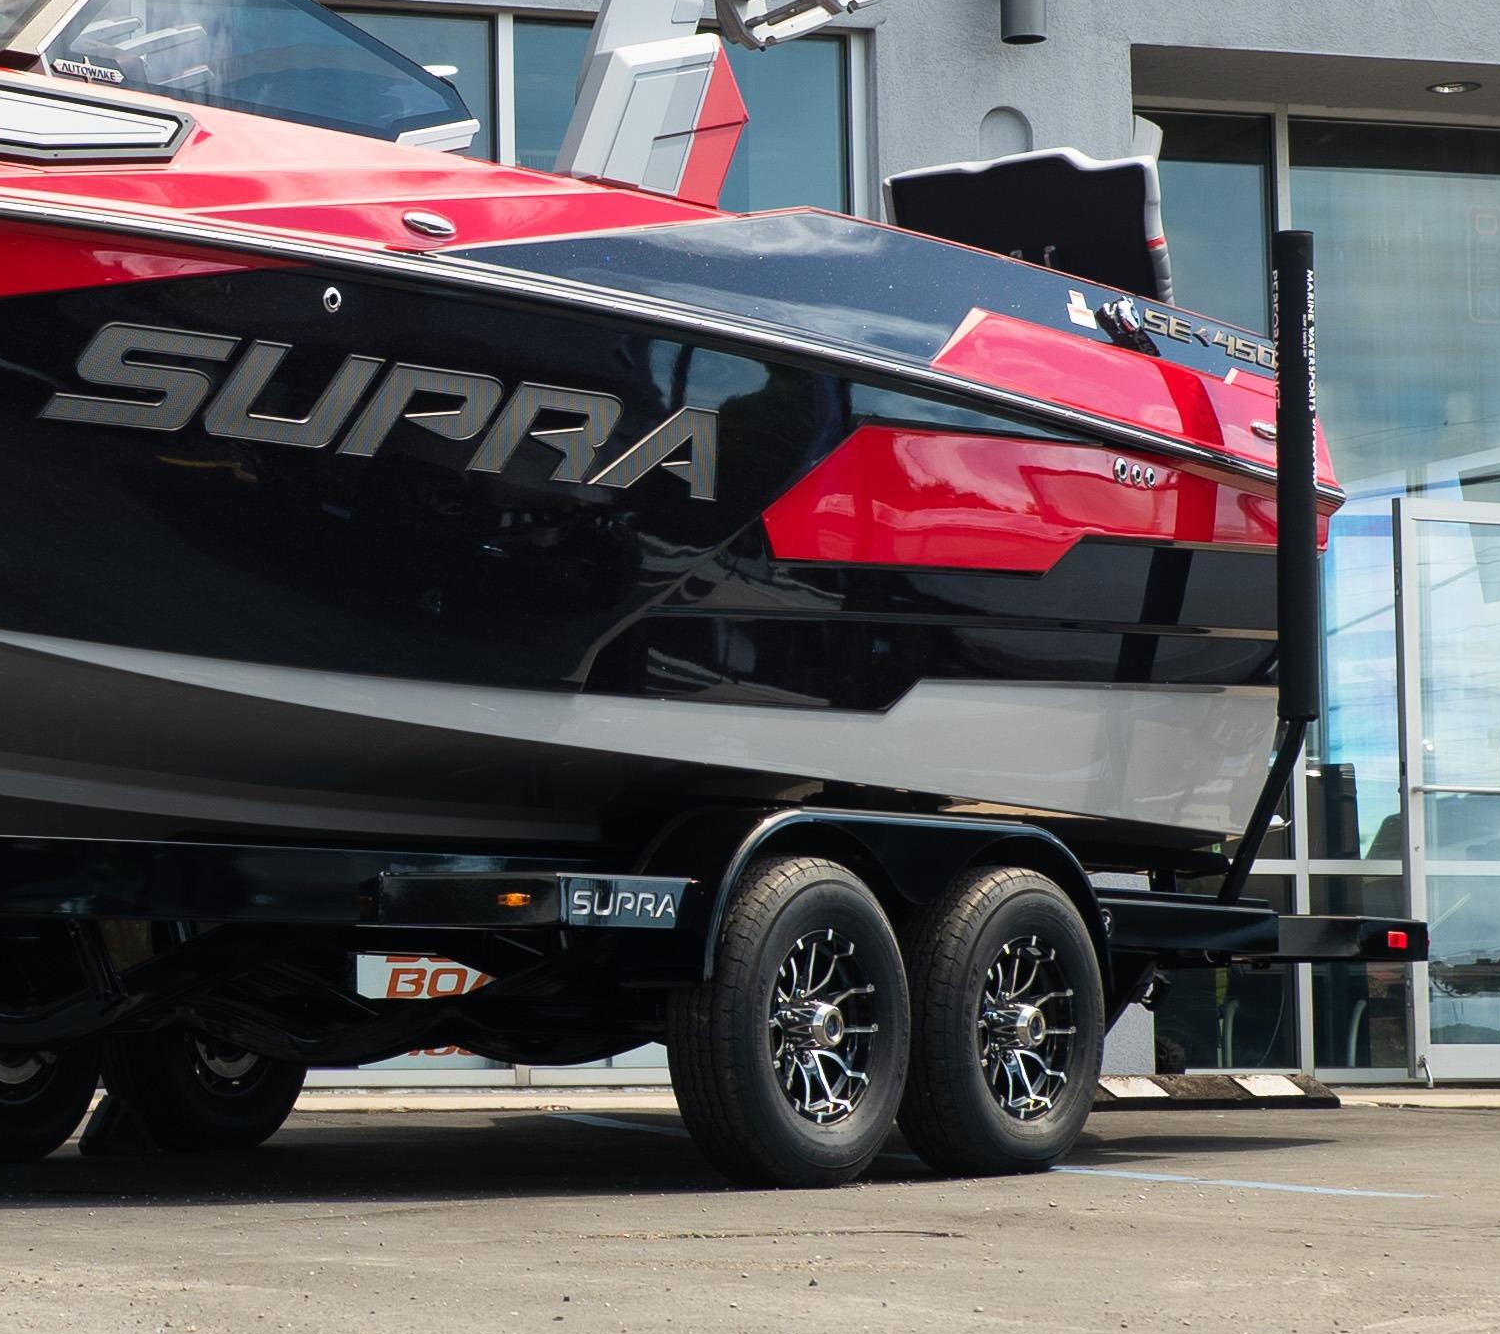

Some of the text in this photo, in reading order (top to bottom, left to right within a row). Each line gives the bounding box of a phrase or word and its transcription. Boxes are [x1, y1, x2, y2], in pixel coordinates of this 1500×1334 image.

[62, 62, 117, 81] AUTOWAKE
[1306, 269, 1315, 323] MARINE
[1143, 308, 1192, 344] SE
[1212, 330, 1279, 372] 450
[36, 321, 720, 501] SUPRA
[571, 889, 677, 918] SUPRA
